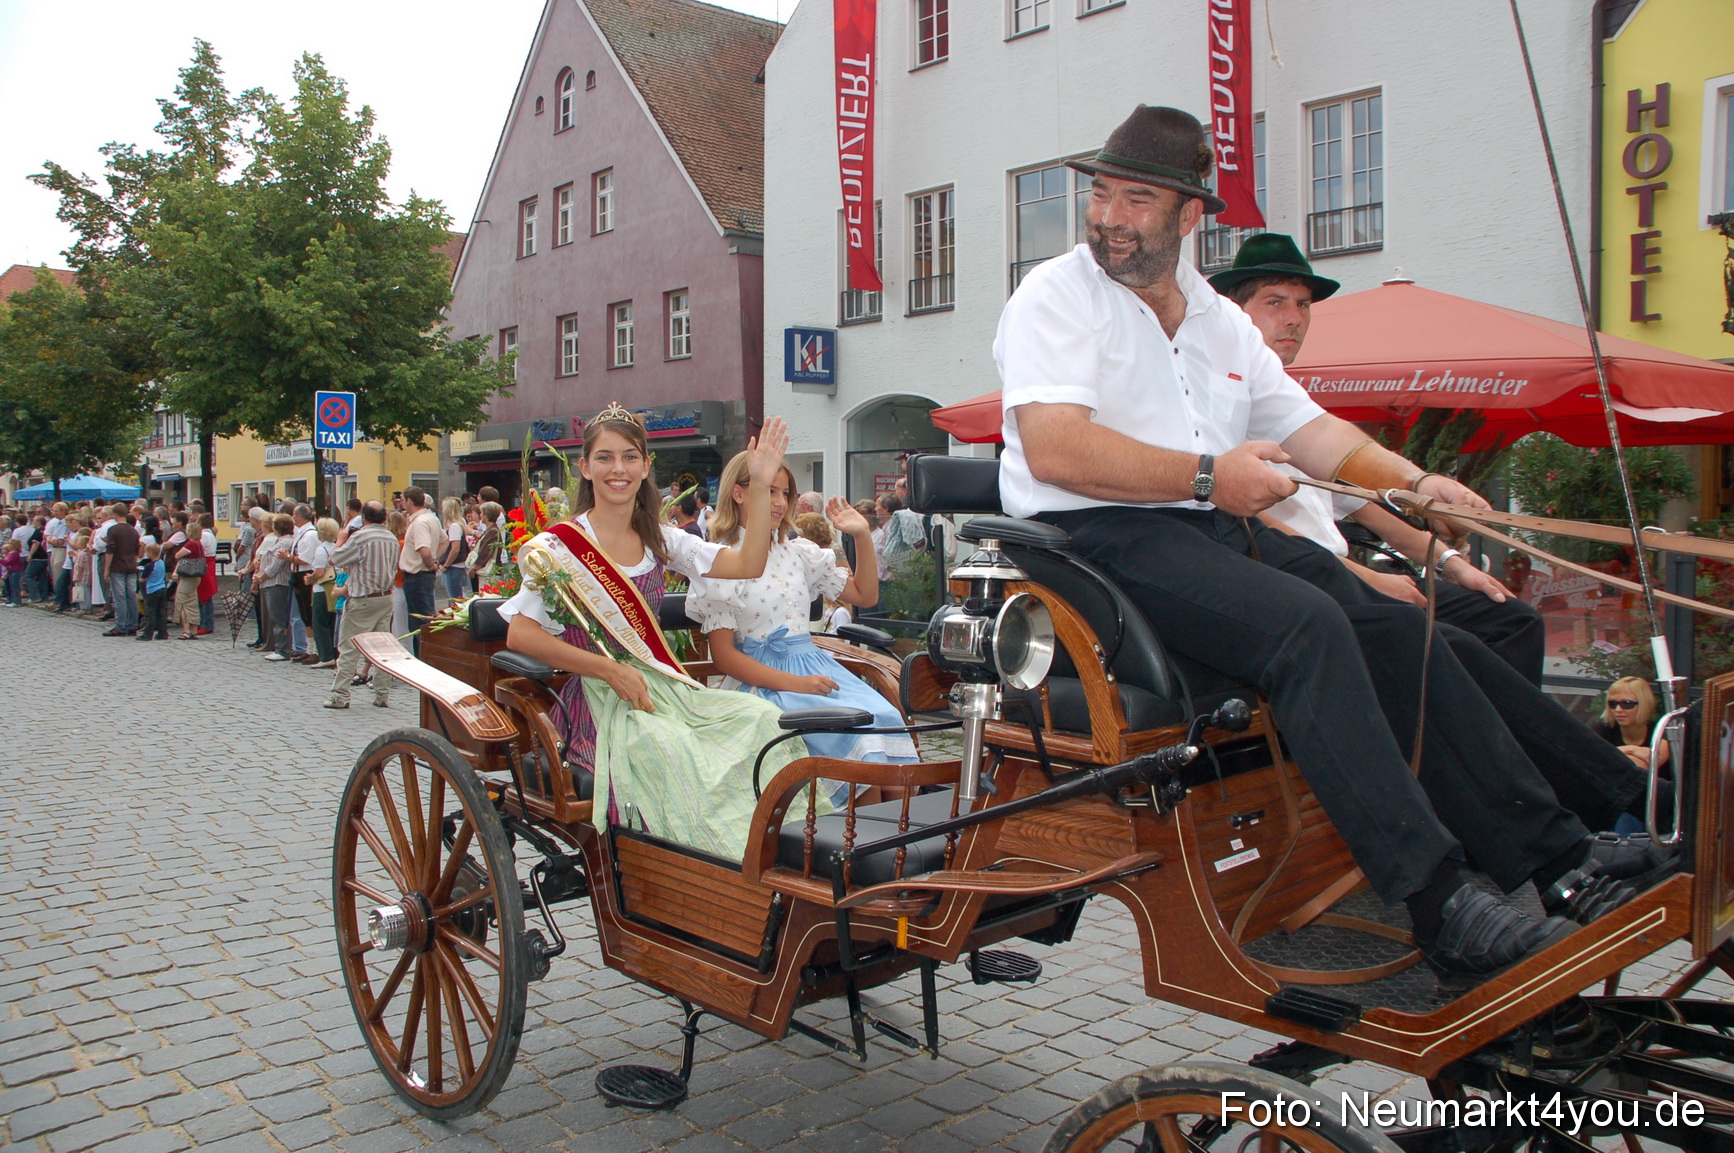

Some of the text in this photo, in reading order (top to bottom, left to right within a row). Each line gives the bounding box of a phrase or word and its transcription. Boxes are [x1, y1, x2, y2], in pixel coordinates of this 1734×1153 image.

[1622, 82, 1673, 323] HOTEL
[1308, 369, 1528, 396] Restaurant Lehmeier
[319, 432, 350, 444] TAXI
